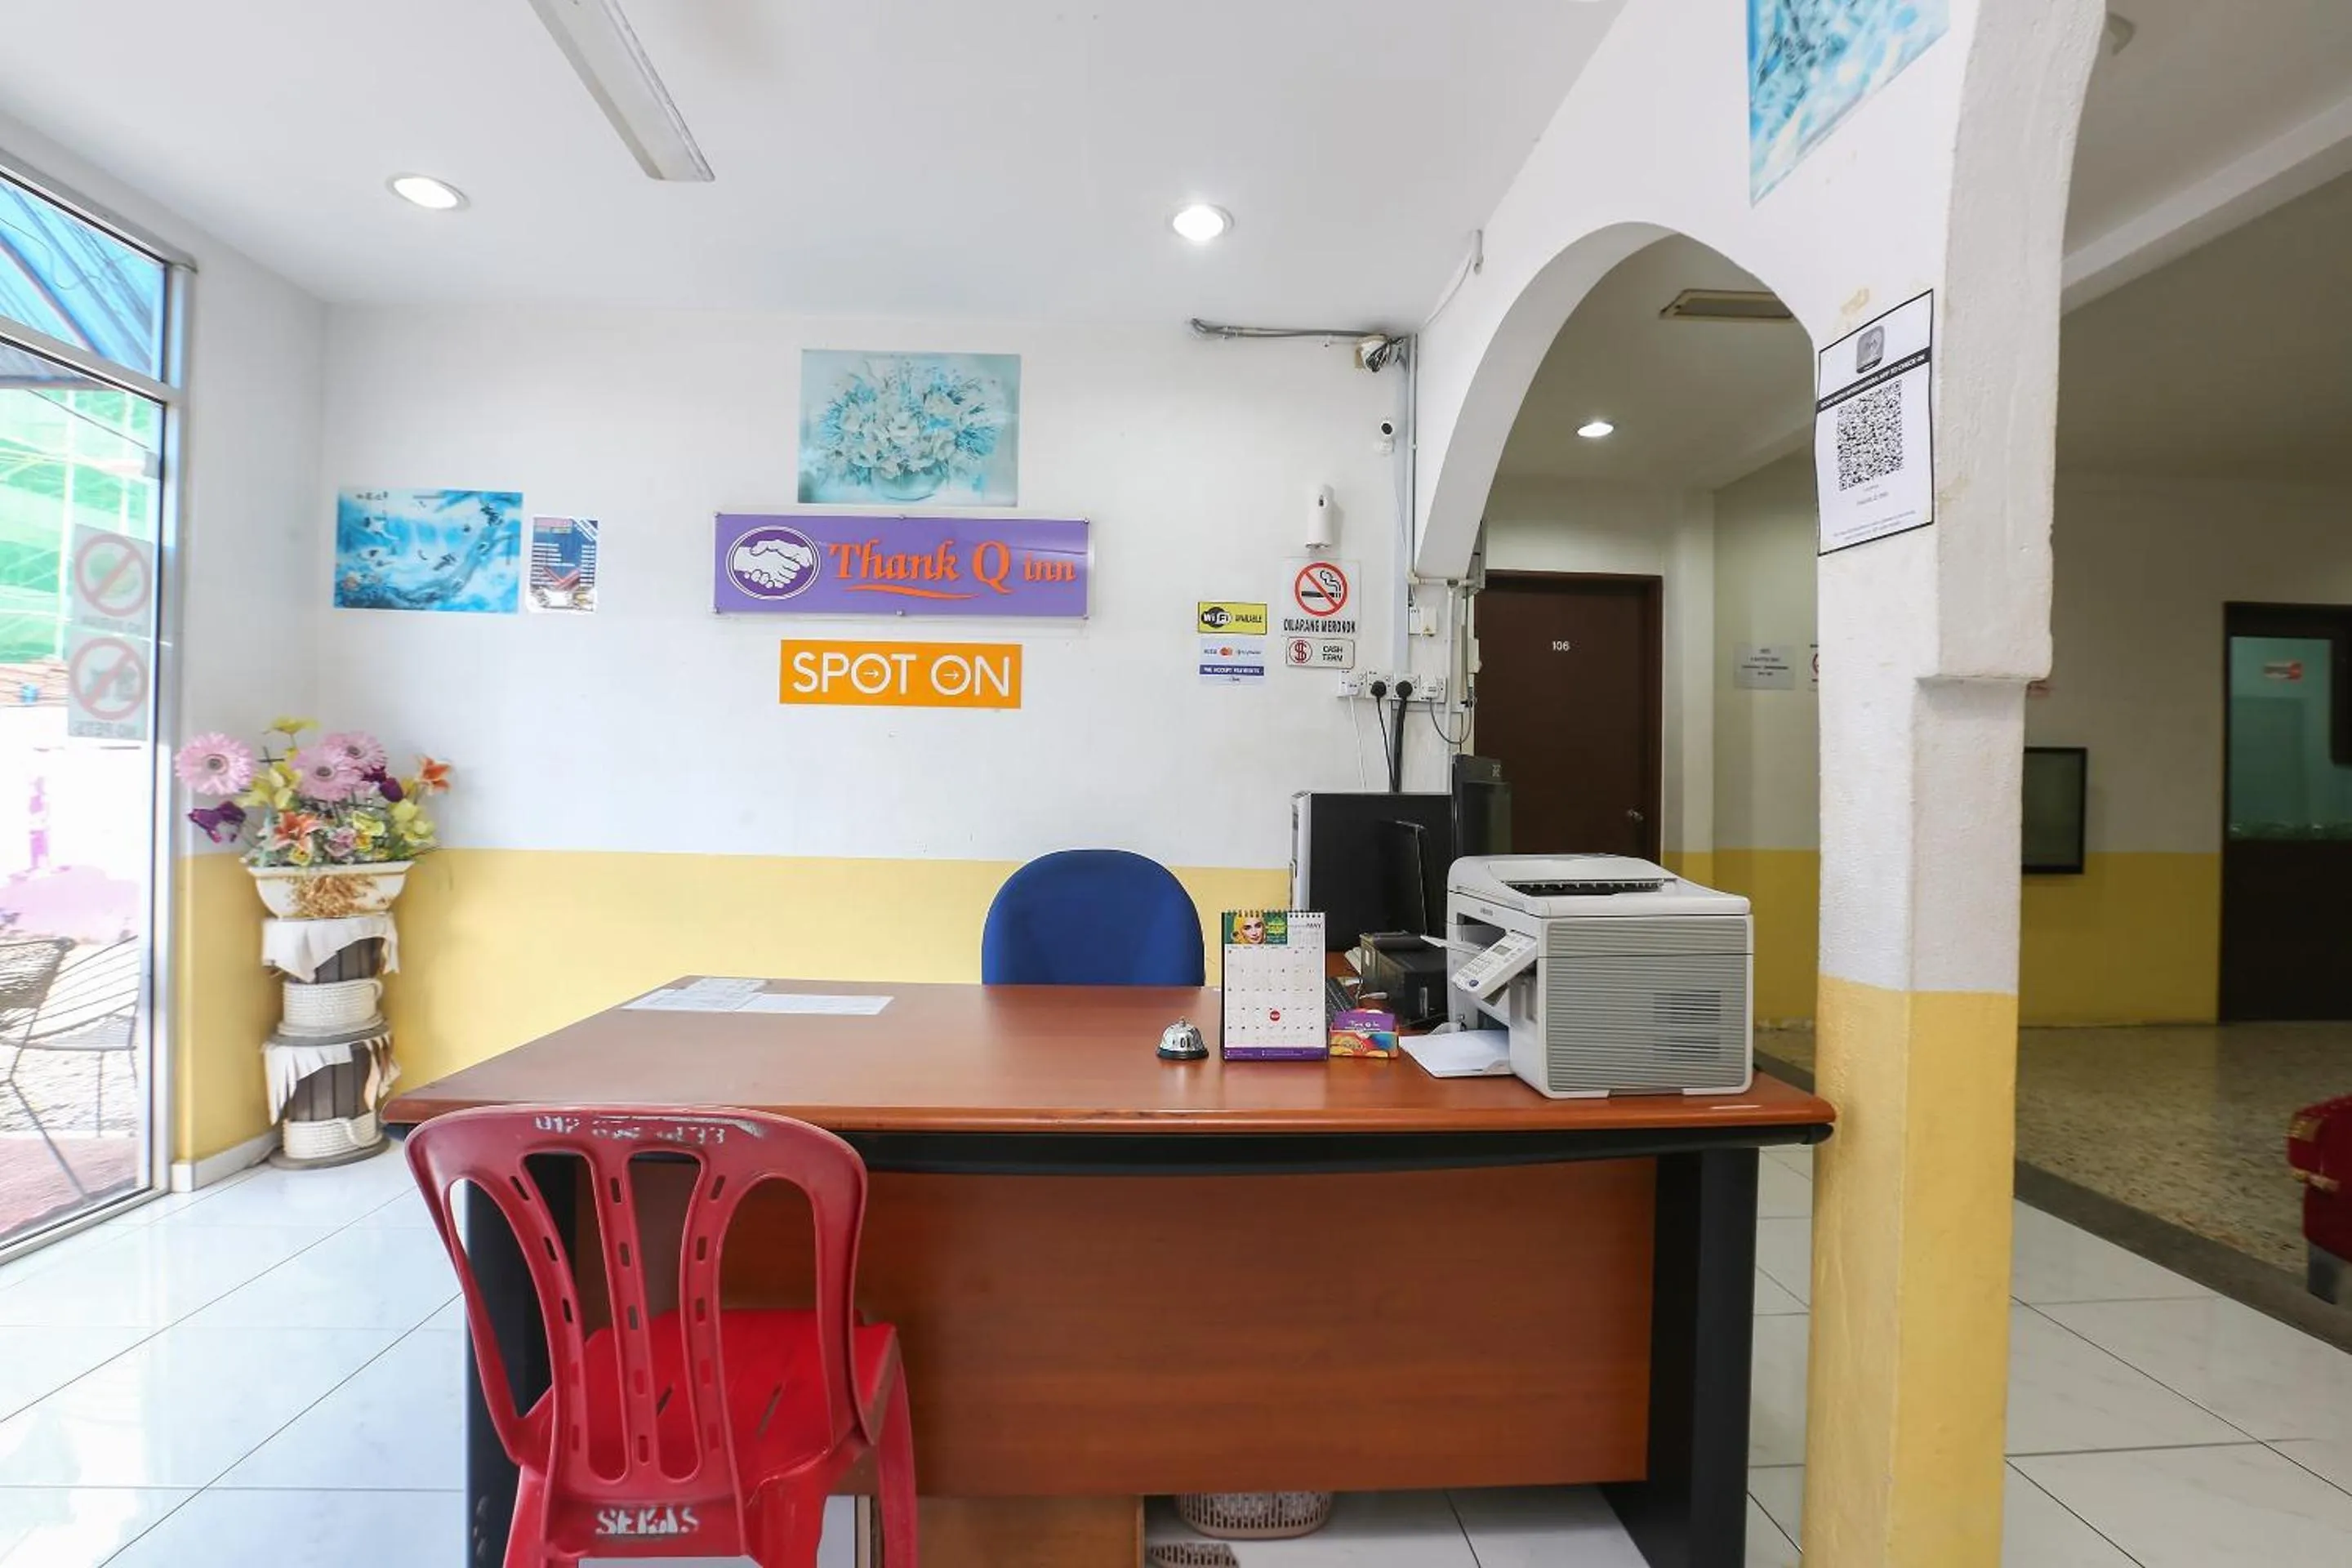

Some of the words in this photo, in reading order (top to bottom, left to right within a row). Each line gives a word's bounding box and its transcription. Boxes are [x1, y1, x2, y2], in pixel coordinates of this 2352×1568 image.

[829, 539, 959, 582] Thank
[971, 540, 1013, 595] Q
[1322, 645, 1343, 653] CASH
[1552, 640, 1570, 652] 106
[792, 651, 916, 694] SPOT
[930, 655, 1010, 697] ON
